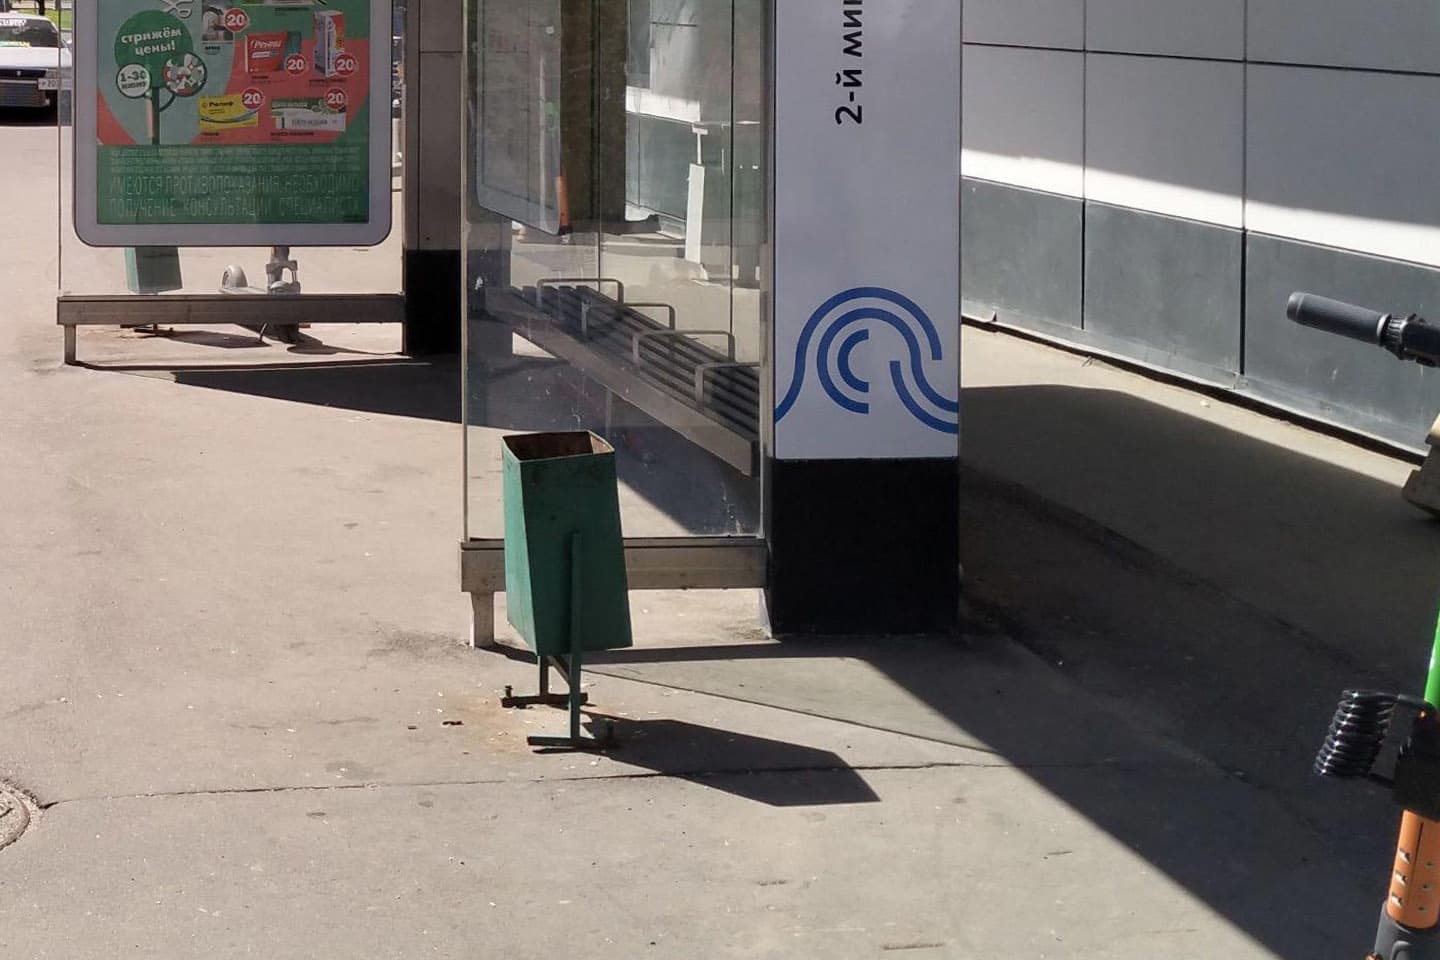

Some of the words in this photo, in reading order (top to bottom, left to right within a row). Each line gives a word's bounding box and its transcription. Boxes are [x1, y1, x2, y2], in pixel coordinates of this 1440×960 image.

[121, 26, 182, 46] стрижём
[135, 39, 176, 57] цены!
[835, 70, 863, 125] 2-й
